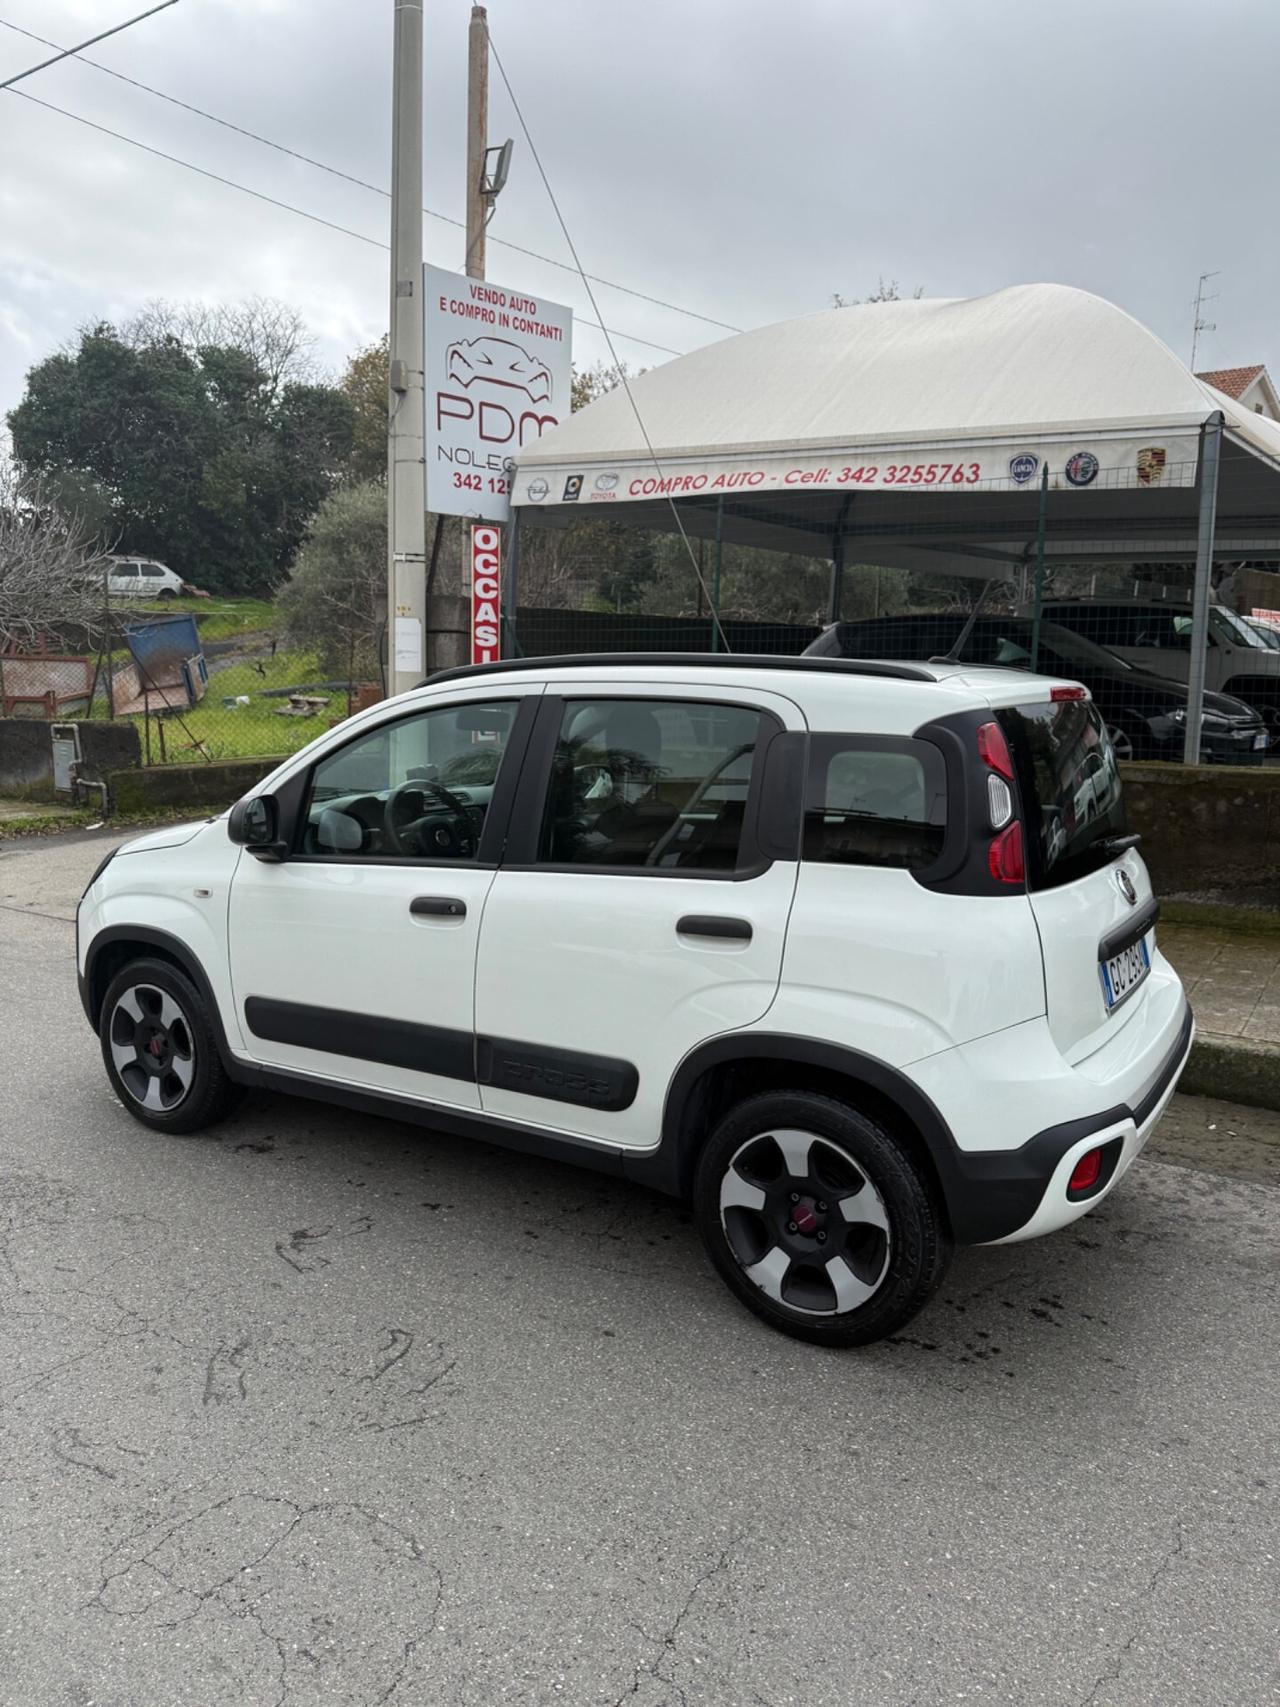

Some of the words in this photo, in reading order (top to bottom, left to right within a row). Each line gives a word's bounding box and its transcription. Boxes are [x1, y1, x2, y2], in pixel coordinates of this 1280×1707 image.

[469, 284, 506, 307] VENDO
[509, 295, 537, 316] AUTO
[439, 296, 447, 311] E
[450, 299, 495, 324] COMPRO
[498, 312, 510, 327] IN
[512, 316, 563, 342] CONTANTI
[453, 472, 482, 491] 342
[629, 473, 708, 497] COMPRO
[711, 471, 766, 488] AUTO
[784, 468, 829, 485] Cell:
[837, 465, 879, 484] 342
[882, 463, 981, 485] 3255763
